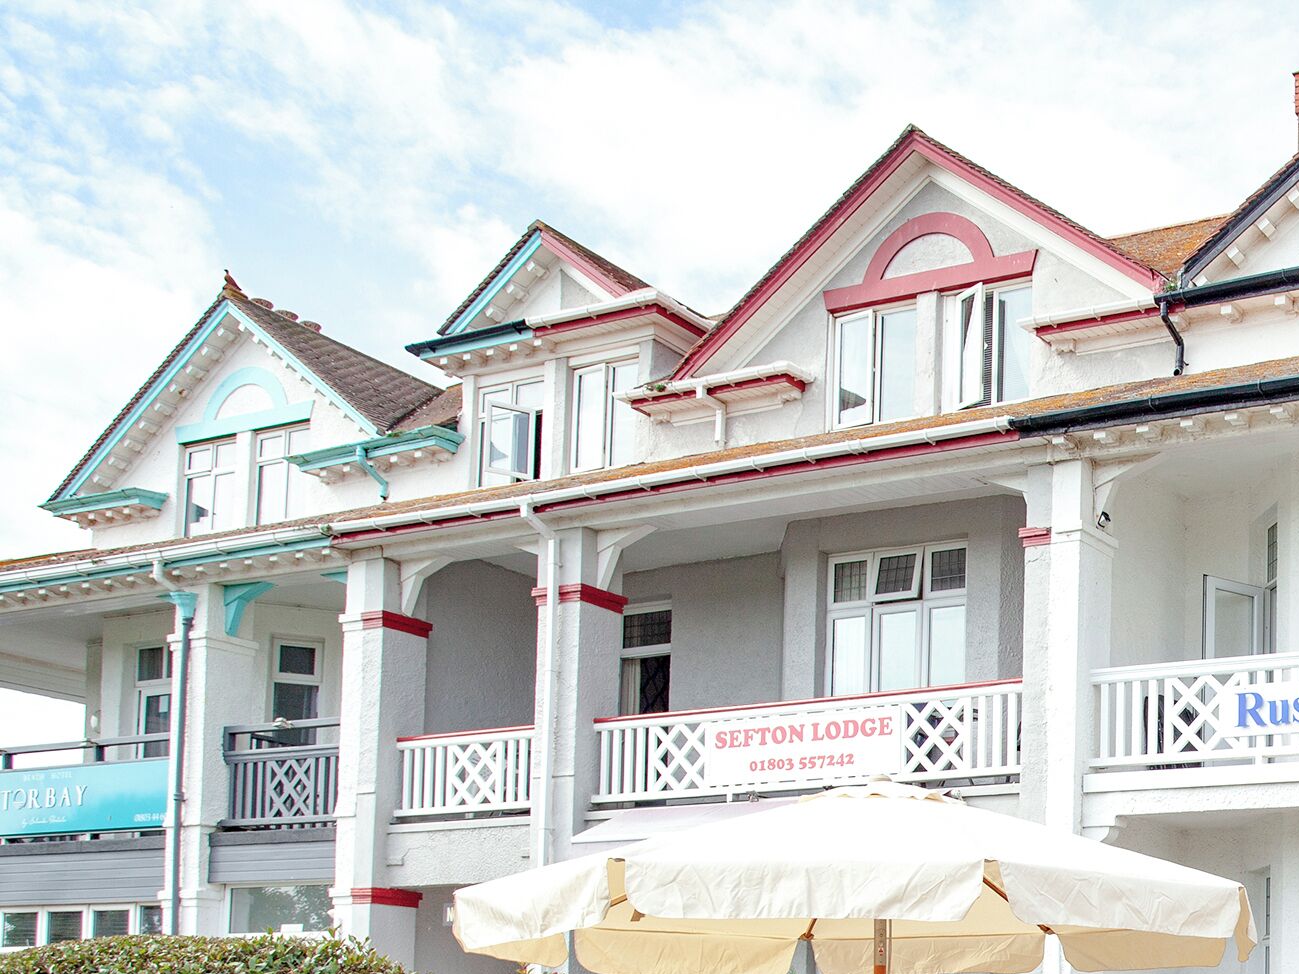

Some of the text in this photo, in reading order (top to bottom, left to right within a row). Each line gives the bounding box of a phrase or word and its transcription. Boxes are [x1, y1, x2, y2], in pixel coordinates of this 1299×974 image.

[715, 716, 893, 749] SEFTON LODGE
[750, 753, 855, 772] 01803 557242
[1, 784, 88, 811] TORBAY
